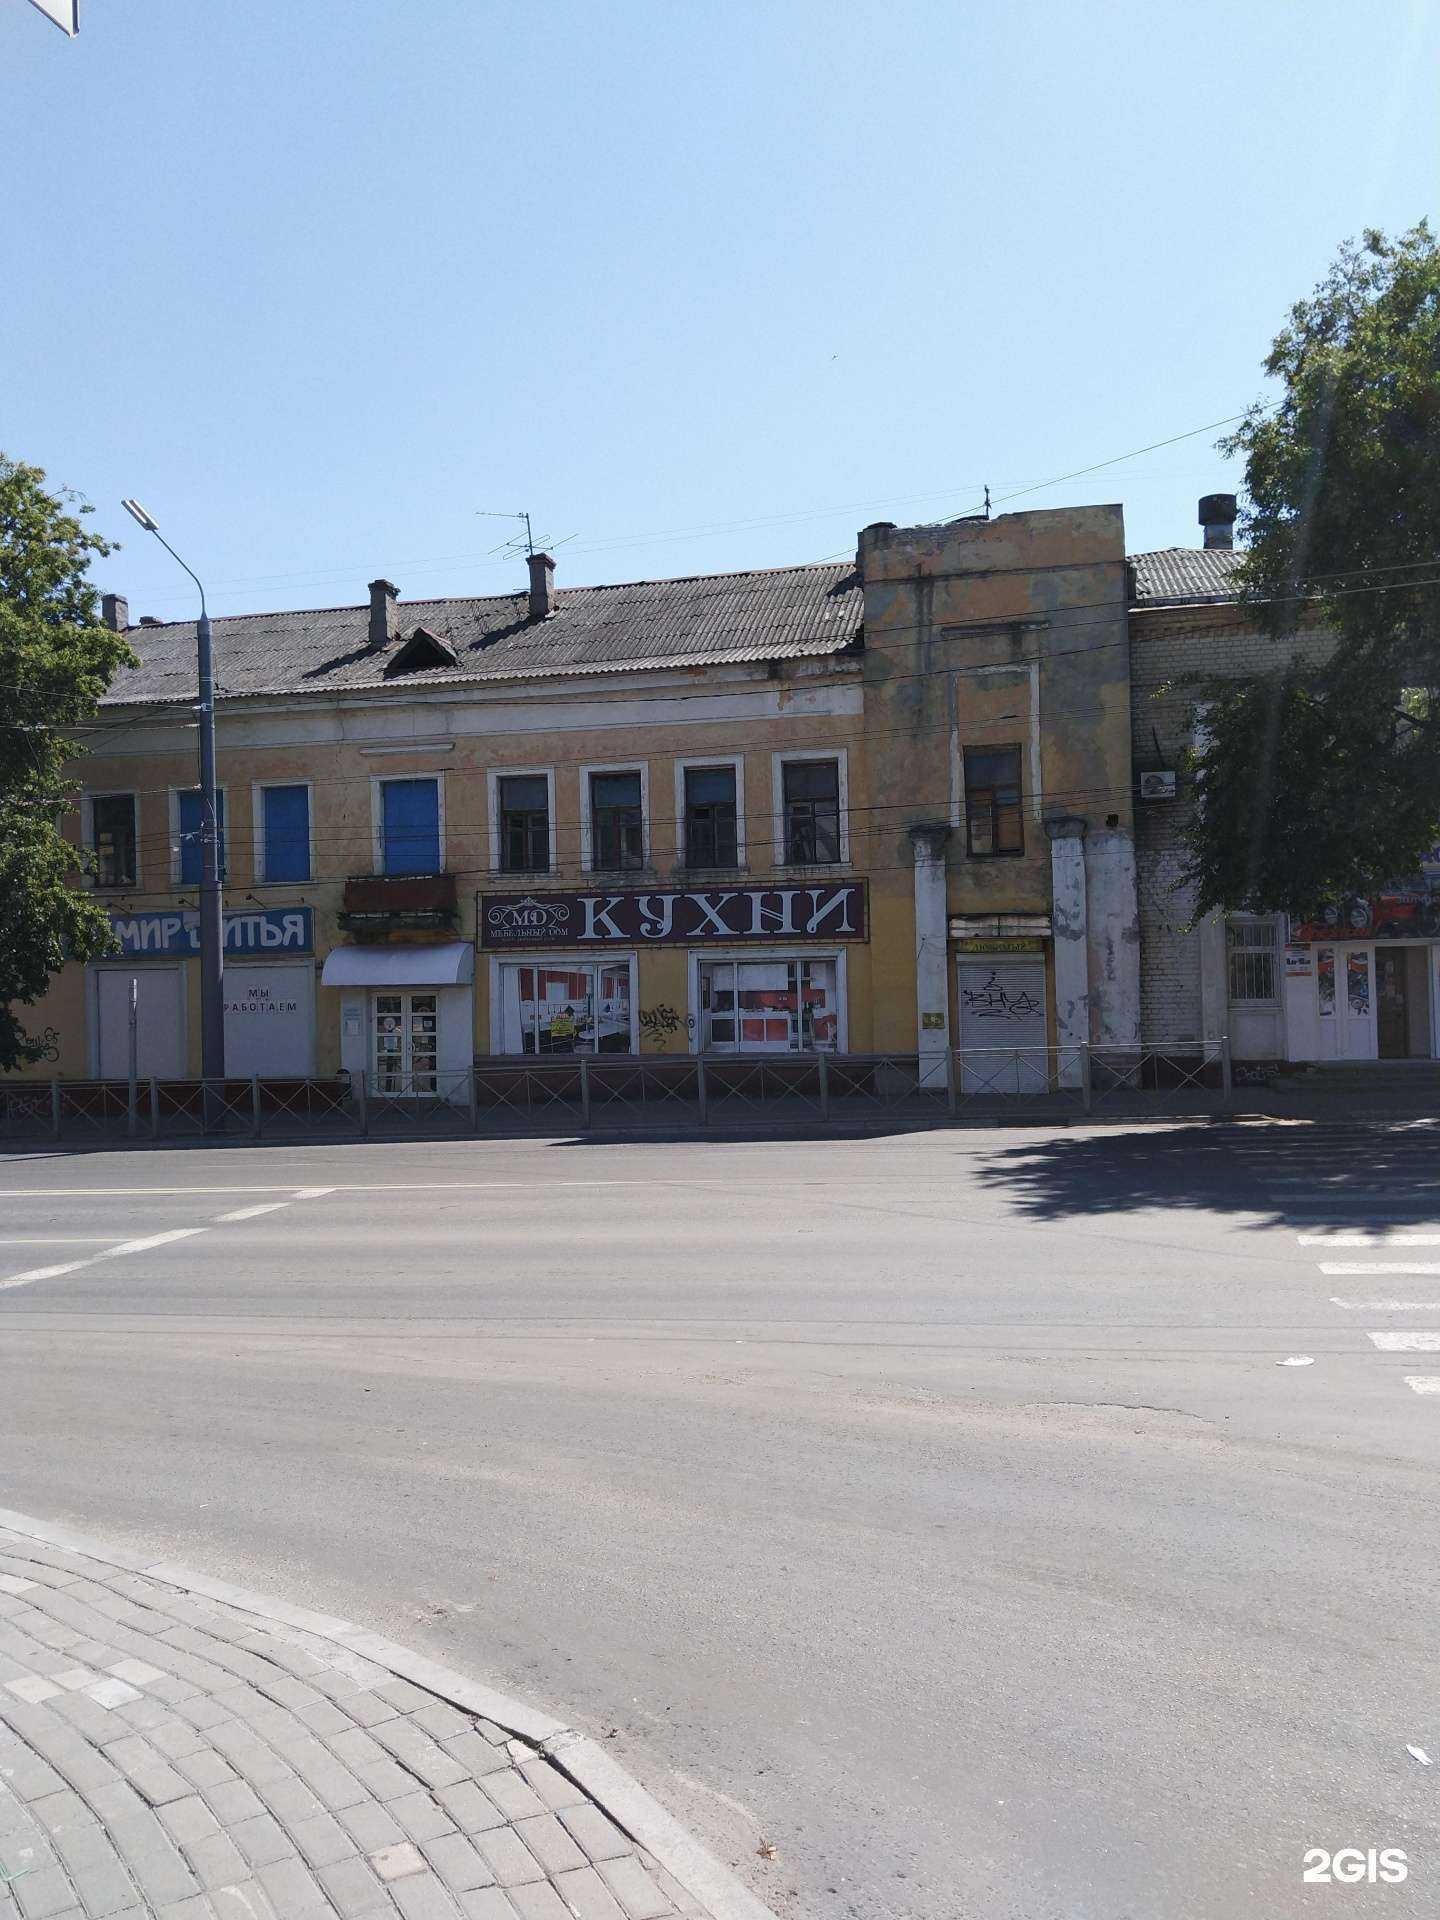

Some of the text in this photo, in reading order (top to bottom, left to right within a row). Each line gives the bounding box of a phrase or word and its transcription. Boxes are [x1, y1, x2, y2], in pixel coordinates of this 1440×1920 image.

[576, 888, 856, 939] КУХНИ
[114, 917, 182, 950] МИР
[489, 927, 546, 937] МЕБЕЛЬНЫЙ
[248, 989, 269, 997] МЫ
